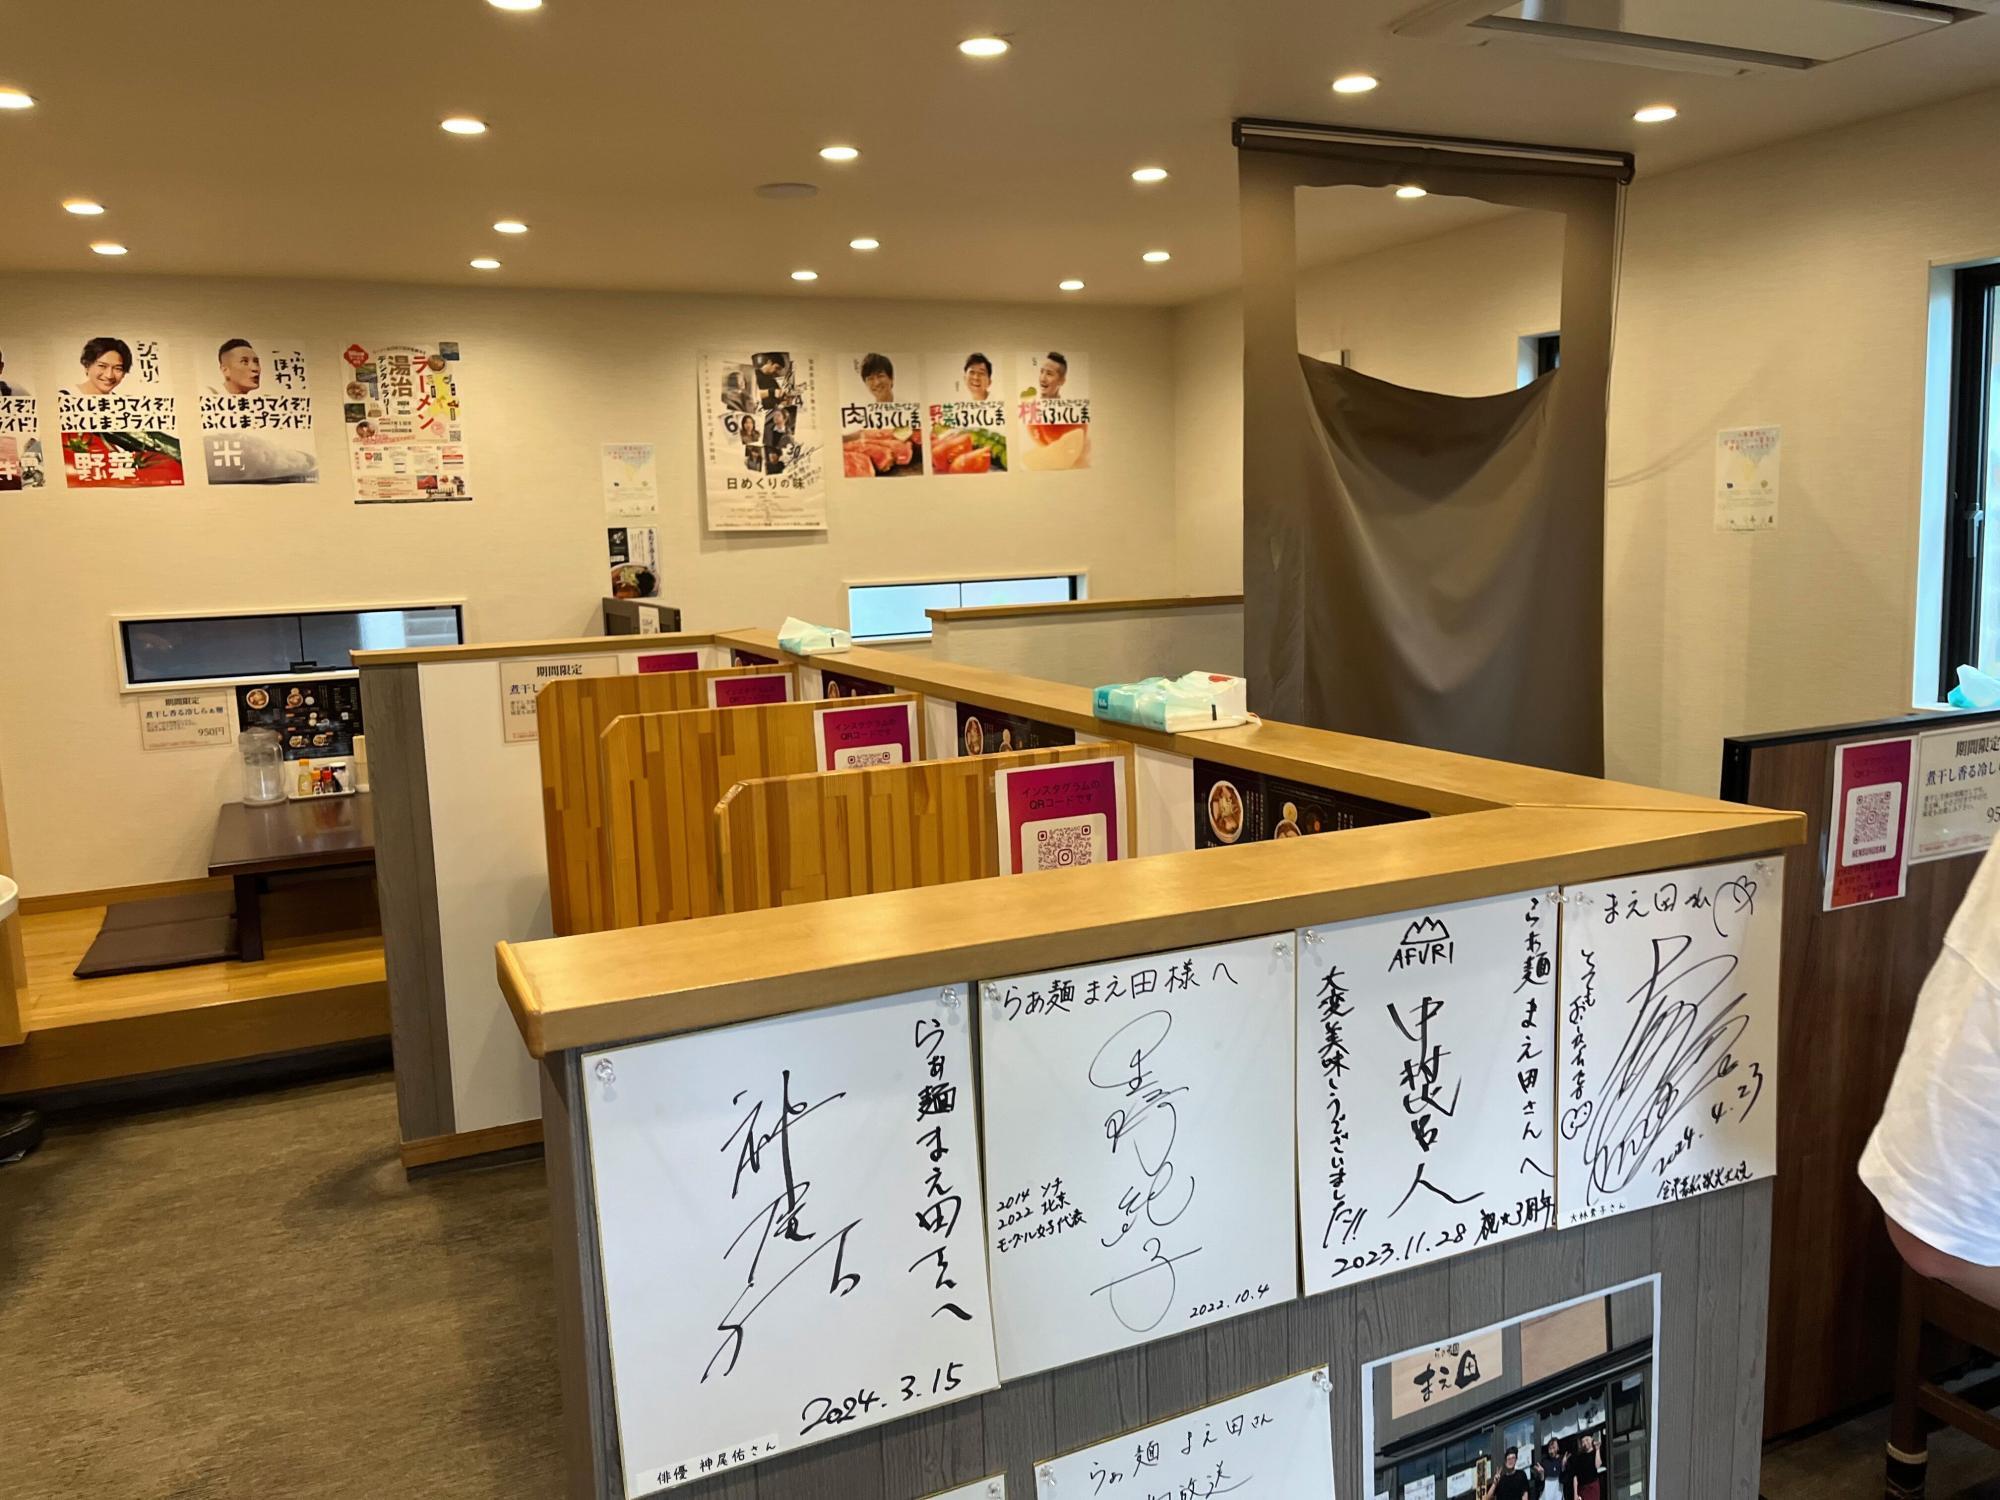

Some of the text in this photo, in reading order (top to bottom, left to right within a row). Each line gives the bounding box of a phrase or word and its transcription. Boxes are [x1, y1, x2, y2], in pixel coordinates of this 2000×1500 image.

[388, 355, 412, 397] 湯治
[413, 355, 434, 430] ラーメン
[74, 451, 136, 480] 野菜
[213, 440, 242, 466] 米
[727, 477, 804, 490] 日めくりの味
[537, 663, 584, 677] 期間限定
[165, 696, 200, 706] 期間限定
[198, 726, 225, 737] 950円
[1023, 779, 1101, 796] インスタグラムの
[1030, 793, 1094, 810] QRコードです
[1388, 942, 1453, 972] AFURI
[996, 1188, 1030, 1212] 2014
[998, 1191, 1071, 1230] 2022 北京
[1414, 1349, 1481, 1402] まえ田
[657, 1442, 776, 1484] 俳優 神尾佑さん
